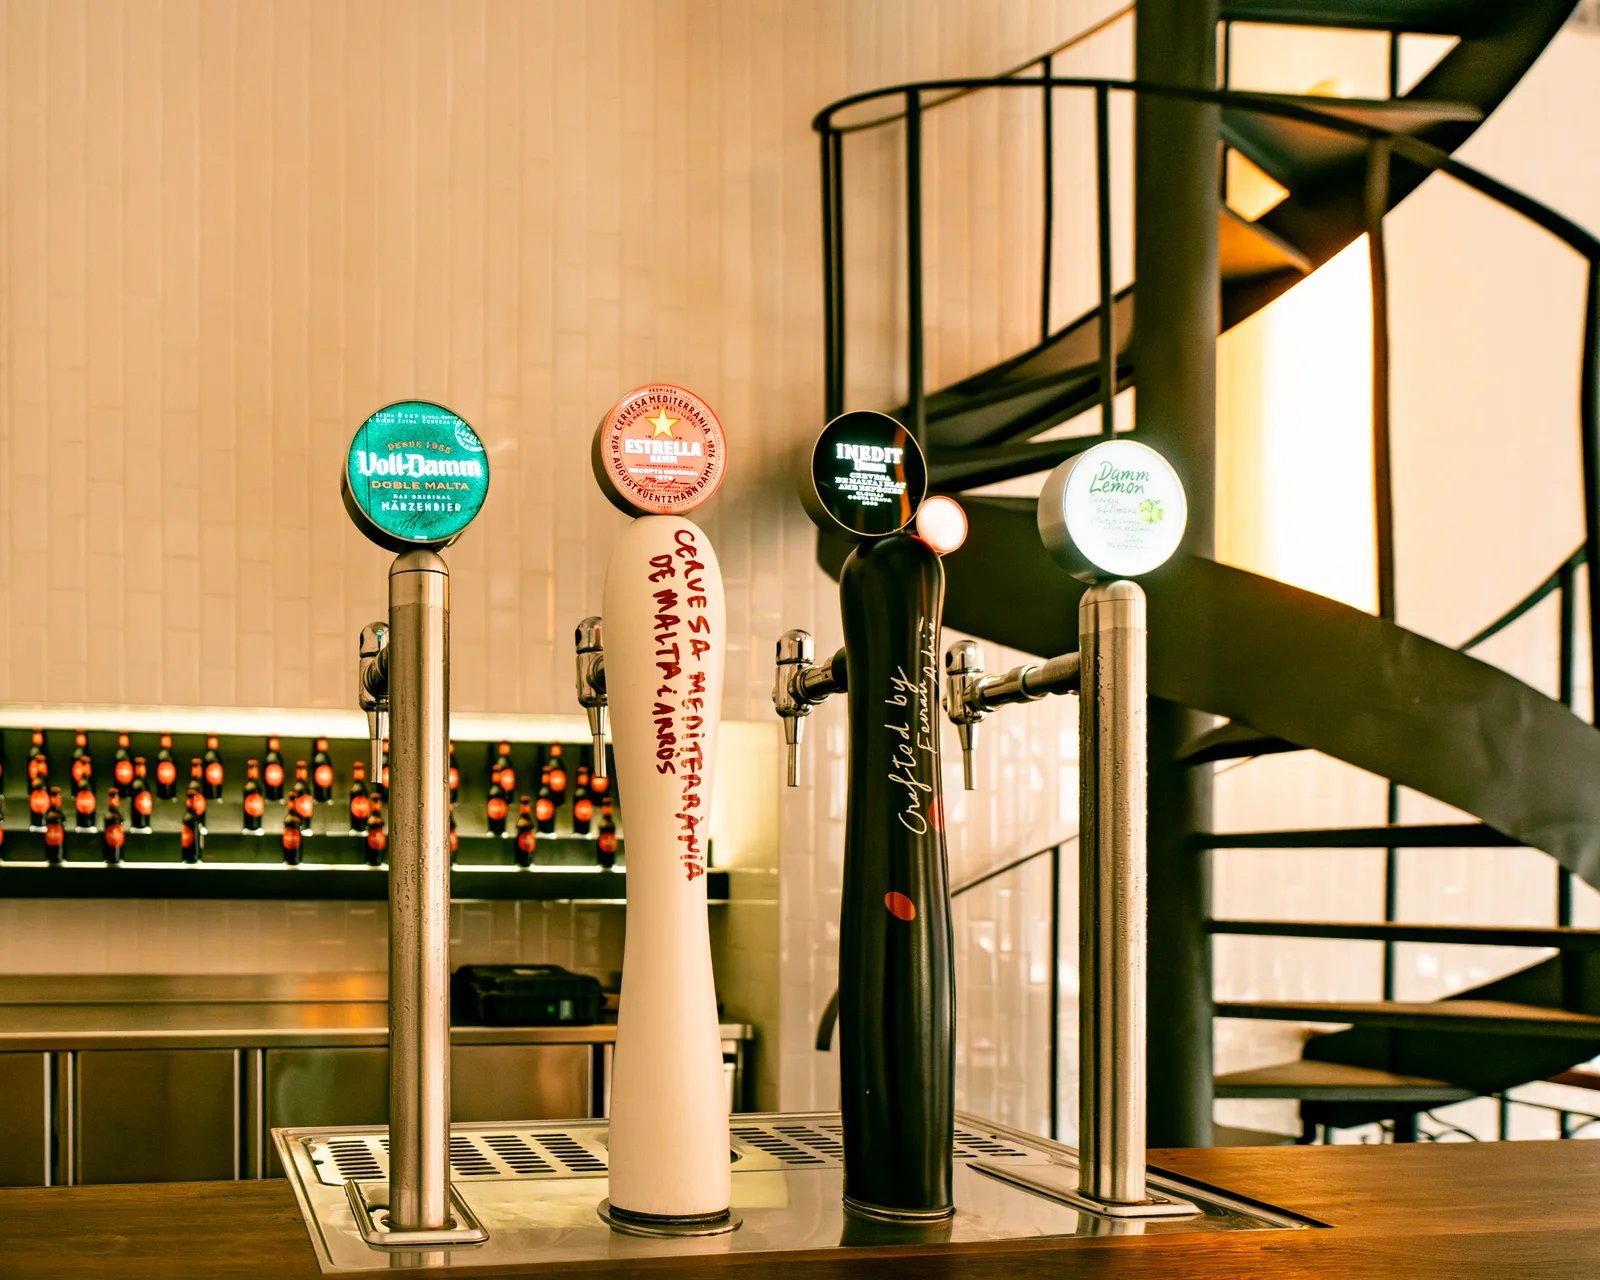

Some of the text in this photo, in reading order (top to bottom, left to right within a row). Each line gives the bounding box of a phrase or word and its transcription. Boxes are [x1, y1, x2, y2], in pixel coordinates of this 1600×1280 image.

[614, 397, 648, 431] CERVESA
[387, 441, 422, 451] DESDE
[611, 435, 620, 453] 1876
[624, 438, 702, 457] ESTRELLA
[707, 440, 716, 458] 1876
[835, 443, 904, 465] INEDIT
[356, 450, 482, 479] Voll-Damm
[1097, 460, 1150, 482] Damm
[371, 480, 470, 491] DOBLE MALTA
[612, 457, 639, 491] AUGUST
[636, 486, 699, 504] KUENTZMANN
[697, 462, 715, 488] DAMM
[834, 476, 849, 484] DE
[848, 478, 880, 487] MALTA
[1088, 473, 1145, 494] Lemon
[381, 499, 462, 512] MÄRZENBIER
[411, 493, 452, 501] ORIGINAL
[648, 554, 676, 583] DE
[652, 589, 682, 681] MALTA
[884, 665, 932, 835] Crafted by
